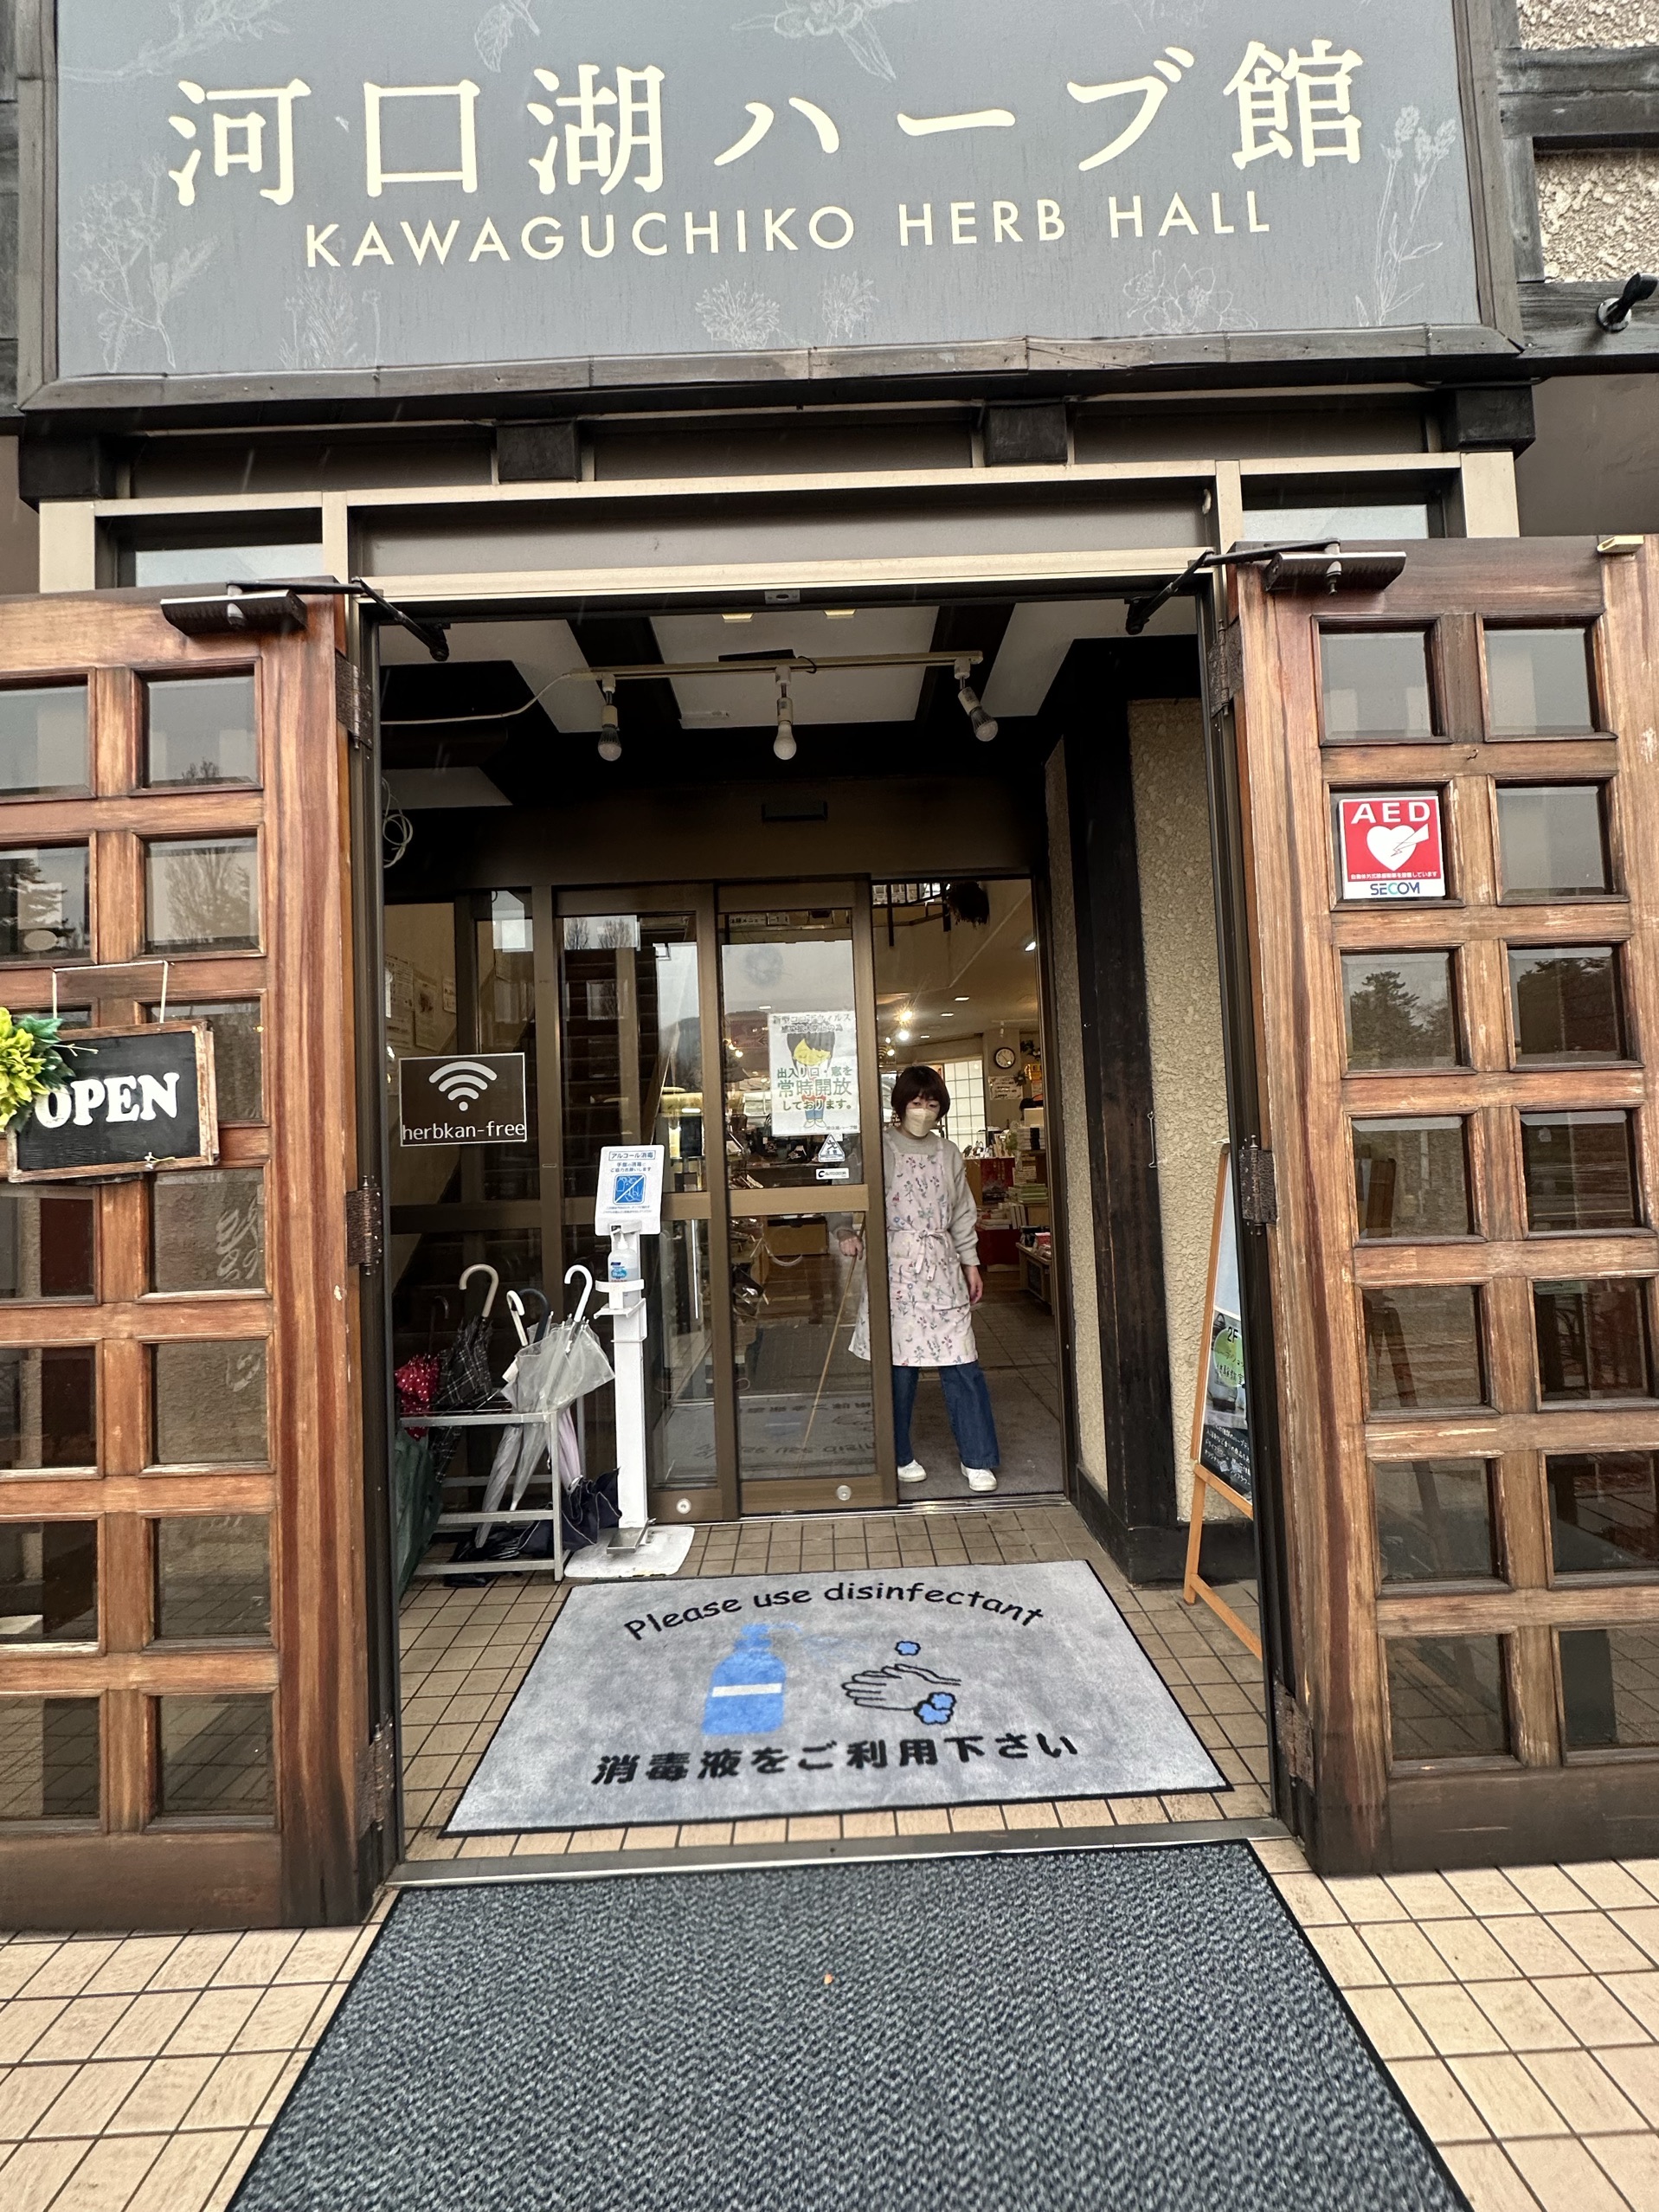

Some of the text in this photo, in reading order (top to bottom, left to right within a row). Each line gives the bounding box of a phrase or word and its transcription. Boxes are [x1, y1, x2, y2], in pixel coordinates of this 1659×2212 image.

[169, 40, 1364, 207] 河口湖ハーブ館
[305, 190, 1270, 268] KAWAGUCHIKO HERB HALL
[1351, 801, 1431, 824] AED
[1370, 882, 1420, 896] SECOM
[778, 1077, 852, 1098] 常時開放
[35, 1072, 180, 1129] OPEN
[782, 1099, 852, 1111] しております。
[402, 1121, 525, 1141] herbkan-free
[1227, 1326, 1238, 1344] 2F
[623, 1582, 1045, 1641] Please use disinfectant
[591, 1732, 1079, 1785] 消毒液をご利用下さい
